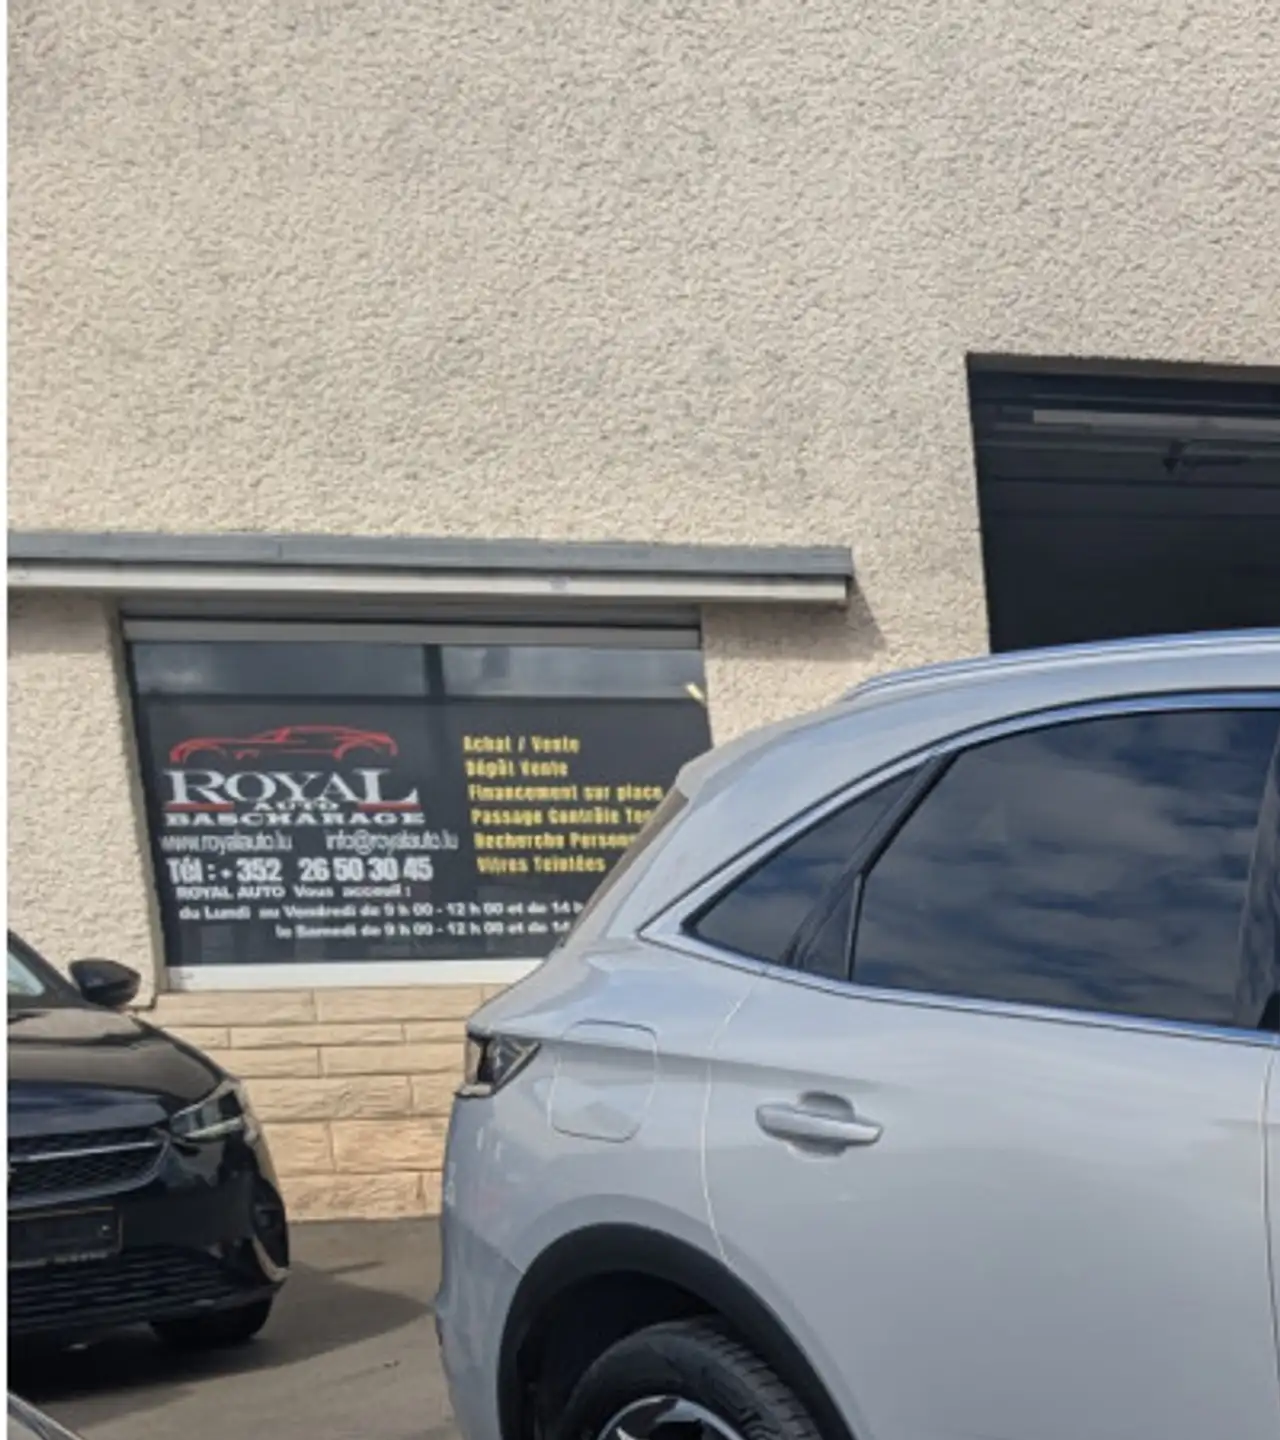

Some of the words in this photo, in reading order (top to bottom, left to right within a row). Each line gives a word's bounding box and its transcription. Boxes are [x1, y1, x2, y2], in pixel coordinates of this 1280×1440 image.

[463, 735, 512, 752] Achat
[531, 736, 580, 753] Vente
[520, 760, 568, 777] Vente
[164, 768, 419, 804] ROYAL
[468, 784, 577, 801] Financement
[583, 786, 610, 800] sur
[254, 797, 340, 811] AUTO
[164, 812, 425, 826] BASCHARAGE
[471, 808, 543, 826] Passage
[547, 807, 620, 824] Contrôle
[474, 832, 565, 849] Recherche
[235, 857, 283, 882] 352
[299, 857, 330, 882] 26
[332, 857, 364, 882] 50
[366, 856, 399, 882] 30
[403, 855, 434, 881] 45
[476, 856, 528, 873] Vitres
[533, 856, 606, 873] Teintées
[175, 886, 233, 899] ROYAL
[237, 886, 286, 898] AUTO
[293, 885, 334, 897] Vous
[179, 906, 200, 920] du
[204, 906, 250, 920] Lundi
[282, 905, 356, 918] Vendredi
[412, 902, 434, 917] 00
[446, 902, 466, 917] 12
[483, 902, 504, 916] 00
[295, 924, 357, 938] Samedi
[447, 922, 466, 936] 12
[483, 921, 504, 935] 00
